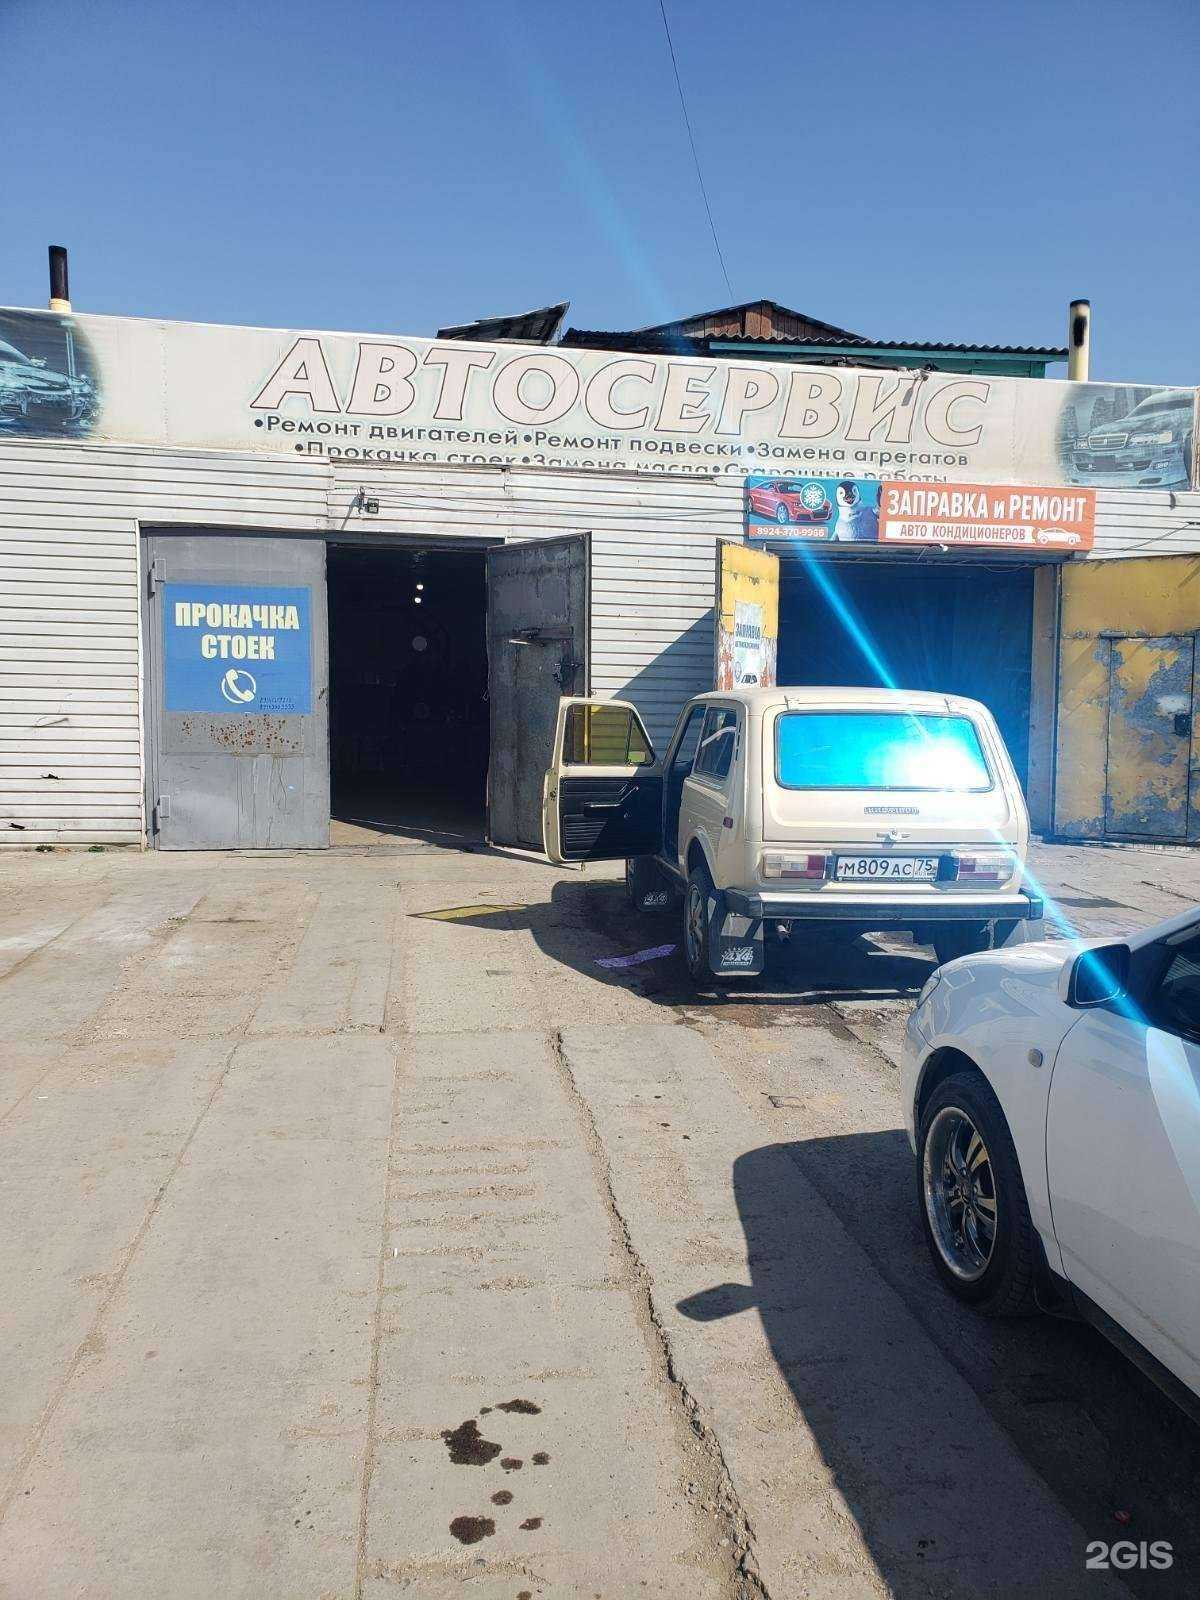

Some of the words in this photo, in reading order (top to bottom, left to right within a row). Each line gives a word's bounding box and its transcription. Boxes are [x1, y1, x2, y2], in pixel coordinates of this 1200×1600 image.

[250, 338, 990, 446] АВТОСЕРВИС
[267, 416, 361, 436] Ремонт
[369, 425, 517, 445] двигателей
[535, 432, 622, 451] Ремонт
[630, 441, 742, 457] подвески
[757, 443, 846, 461] Замена
[855, 449, 968, 467] агрегатов
[307, 442, 437, 462] Прокачка
[887, 489, 989, 519] ЗАПРАВКА
[993, 499, 1005, 519] и
[1008, 494, 1087, 522] РЕМОНТ
[900, 523, 928, 538] АВТО
[932, 525, 1026, 541] КОНДИЦИОНЕРОВ
[175, 602, 300, 630] ПРОКАЧКА
[201, 634, 275, 660] СТОЕК
[917, 859, 933, 872] 75
